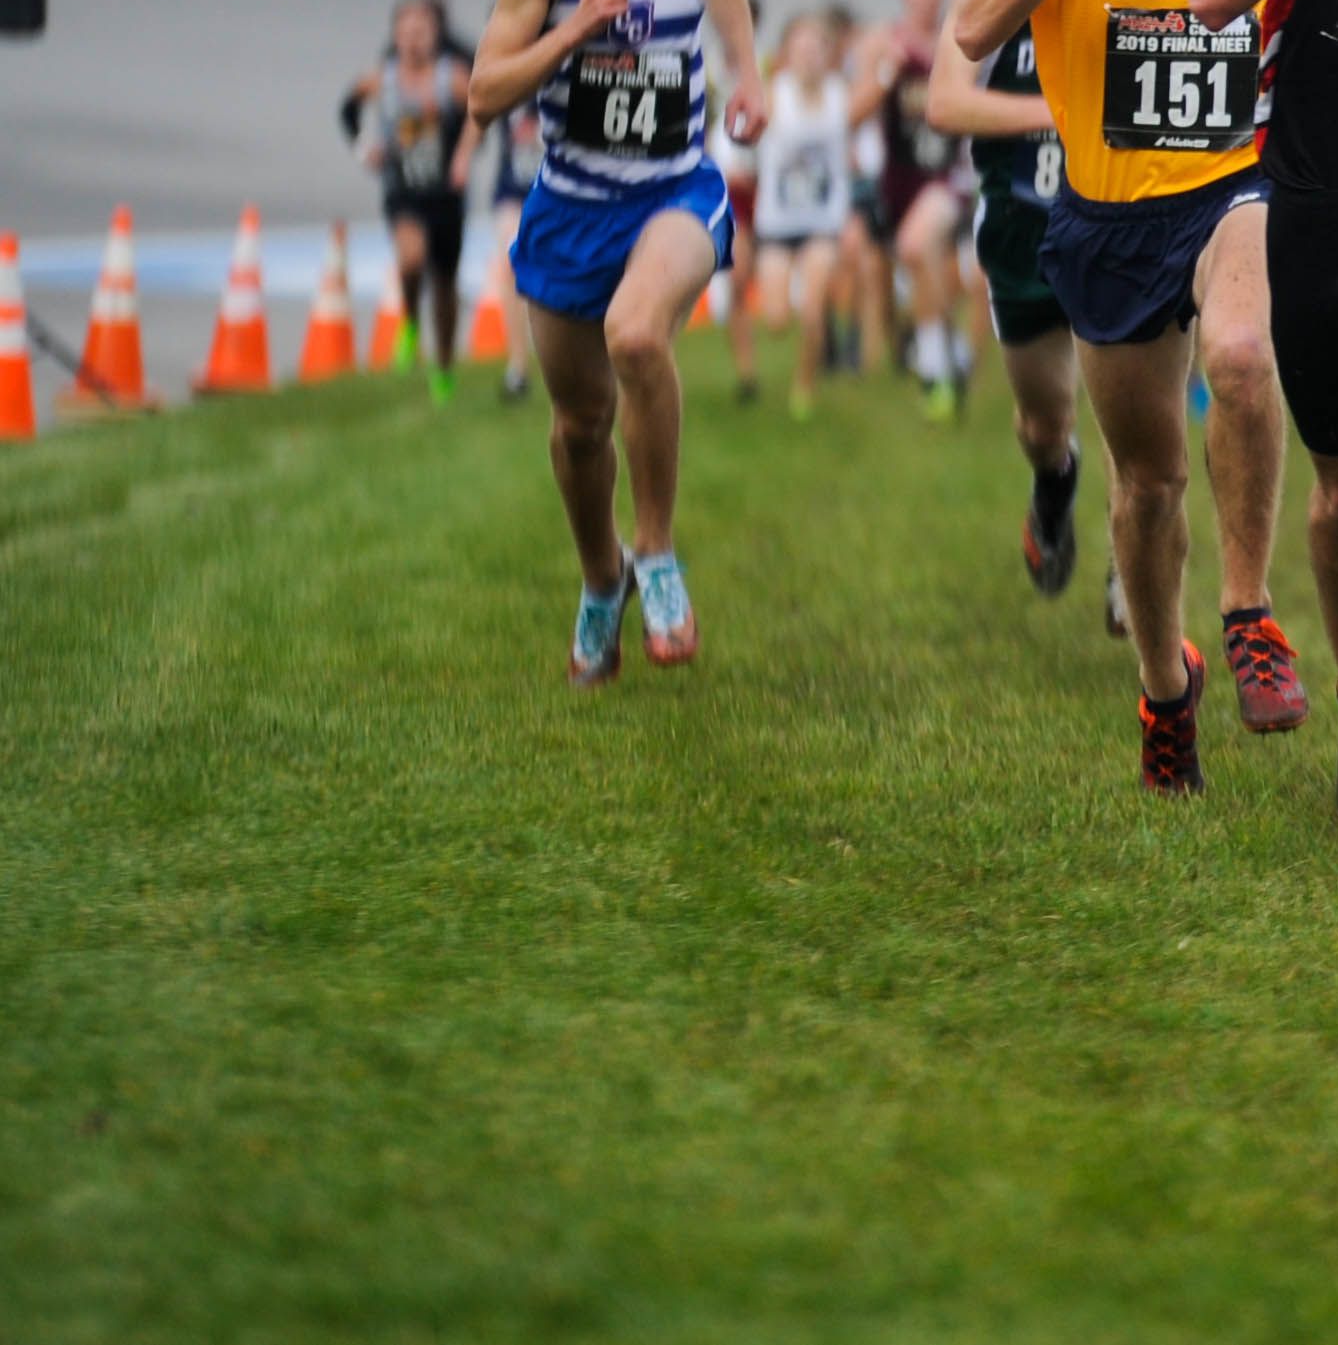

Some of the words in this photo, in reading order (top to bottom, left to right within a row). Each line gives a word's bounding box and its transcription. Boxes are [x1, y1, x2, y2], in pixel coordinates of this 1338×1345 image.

[1116, 35, 1159, 52] 2019
[1161, 36, 1208, 53] FINAL
[1211, 37, 1252, 53] MEET
[603, 88, 658, 145] 64
[1132, 60, 1232, 128] 151
